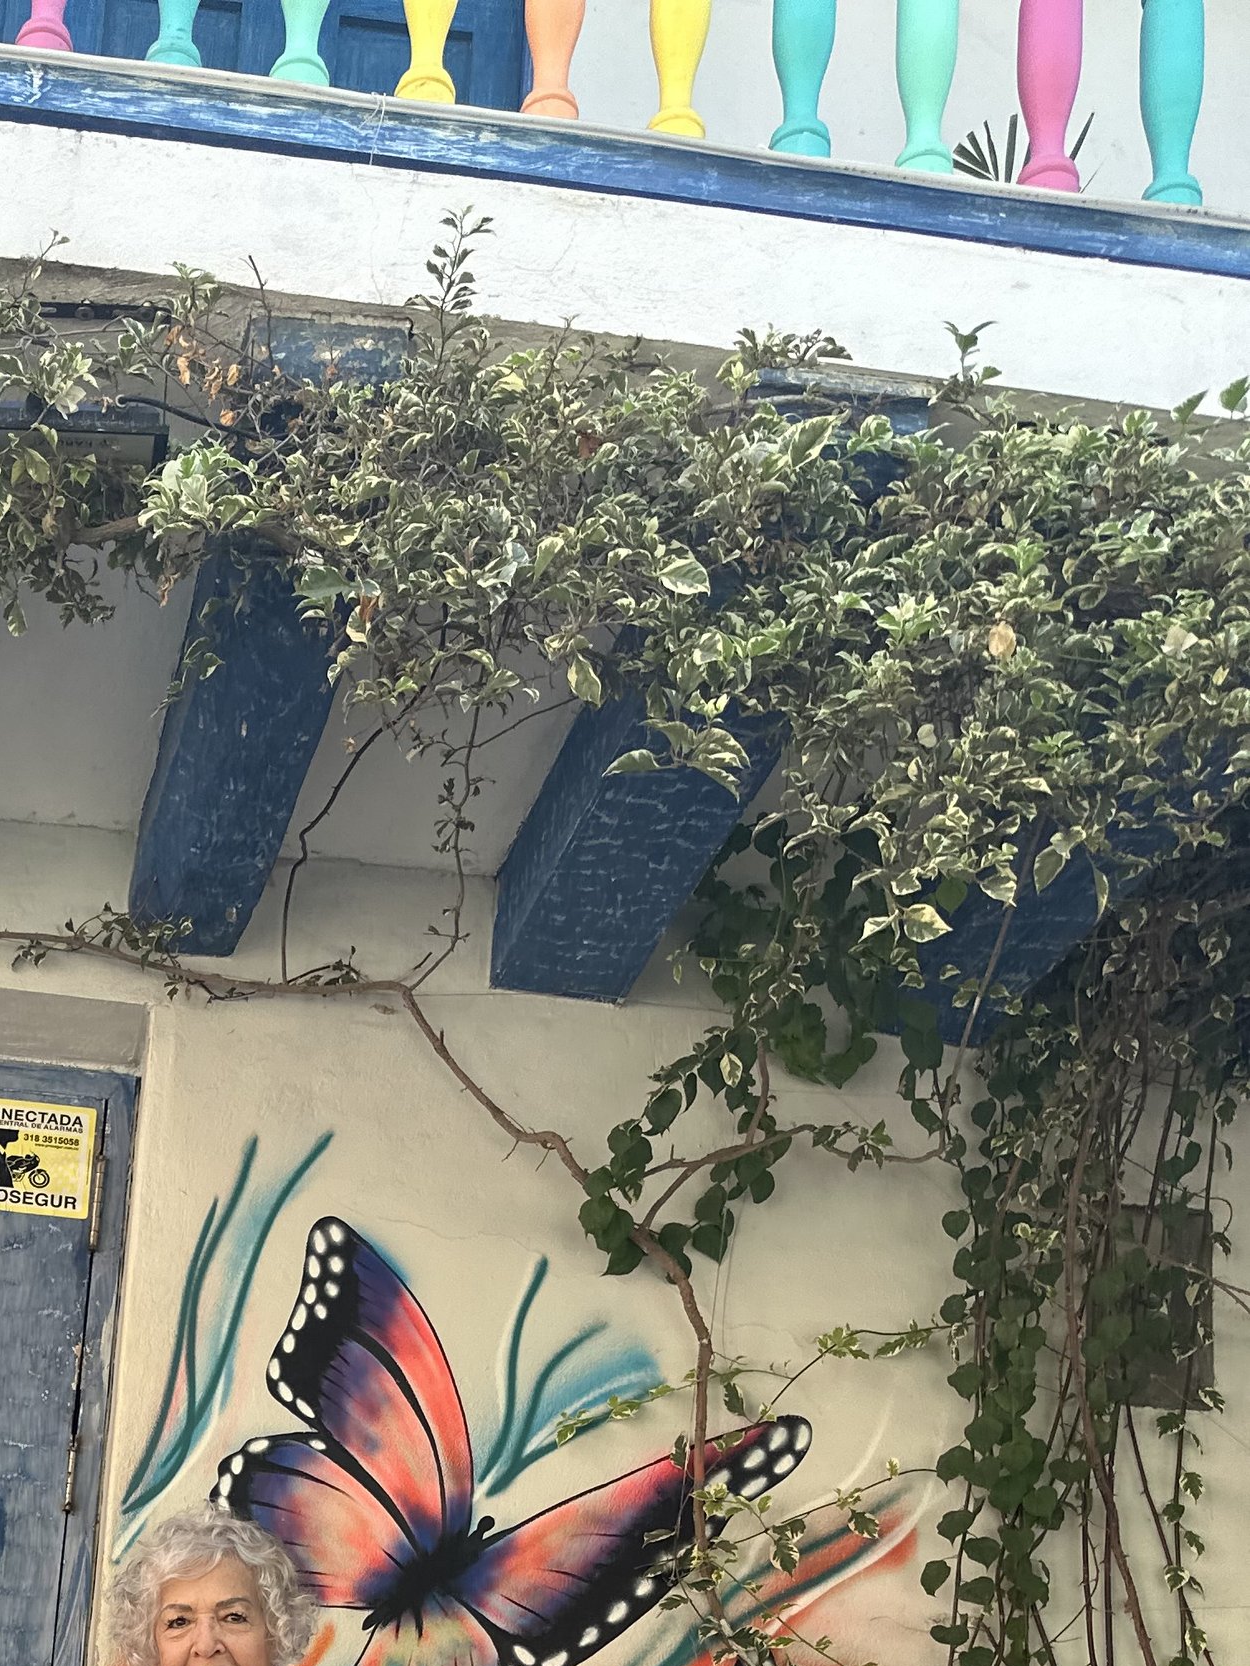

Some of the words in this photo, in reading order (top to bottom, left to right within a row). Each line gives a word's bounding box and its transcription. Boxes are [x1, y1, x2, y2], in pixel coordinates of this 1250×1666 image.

[31, 1122, 41, 1130] DE
[43, 1124, 84, 1134] ALARMAS
[23, 1133, 40, 1143] 318
